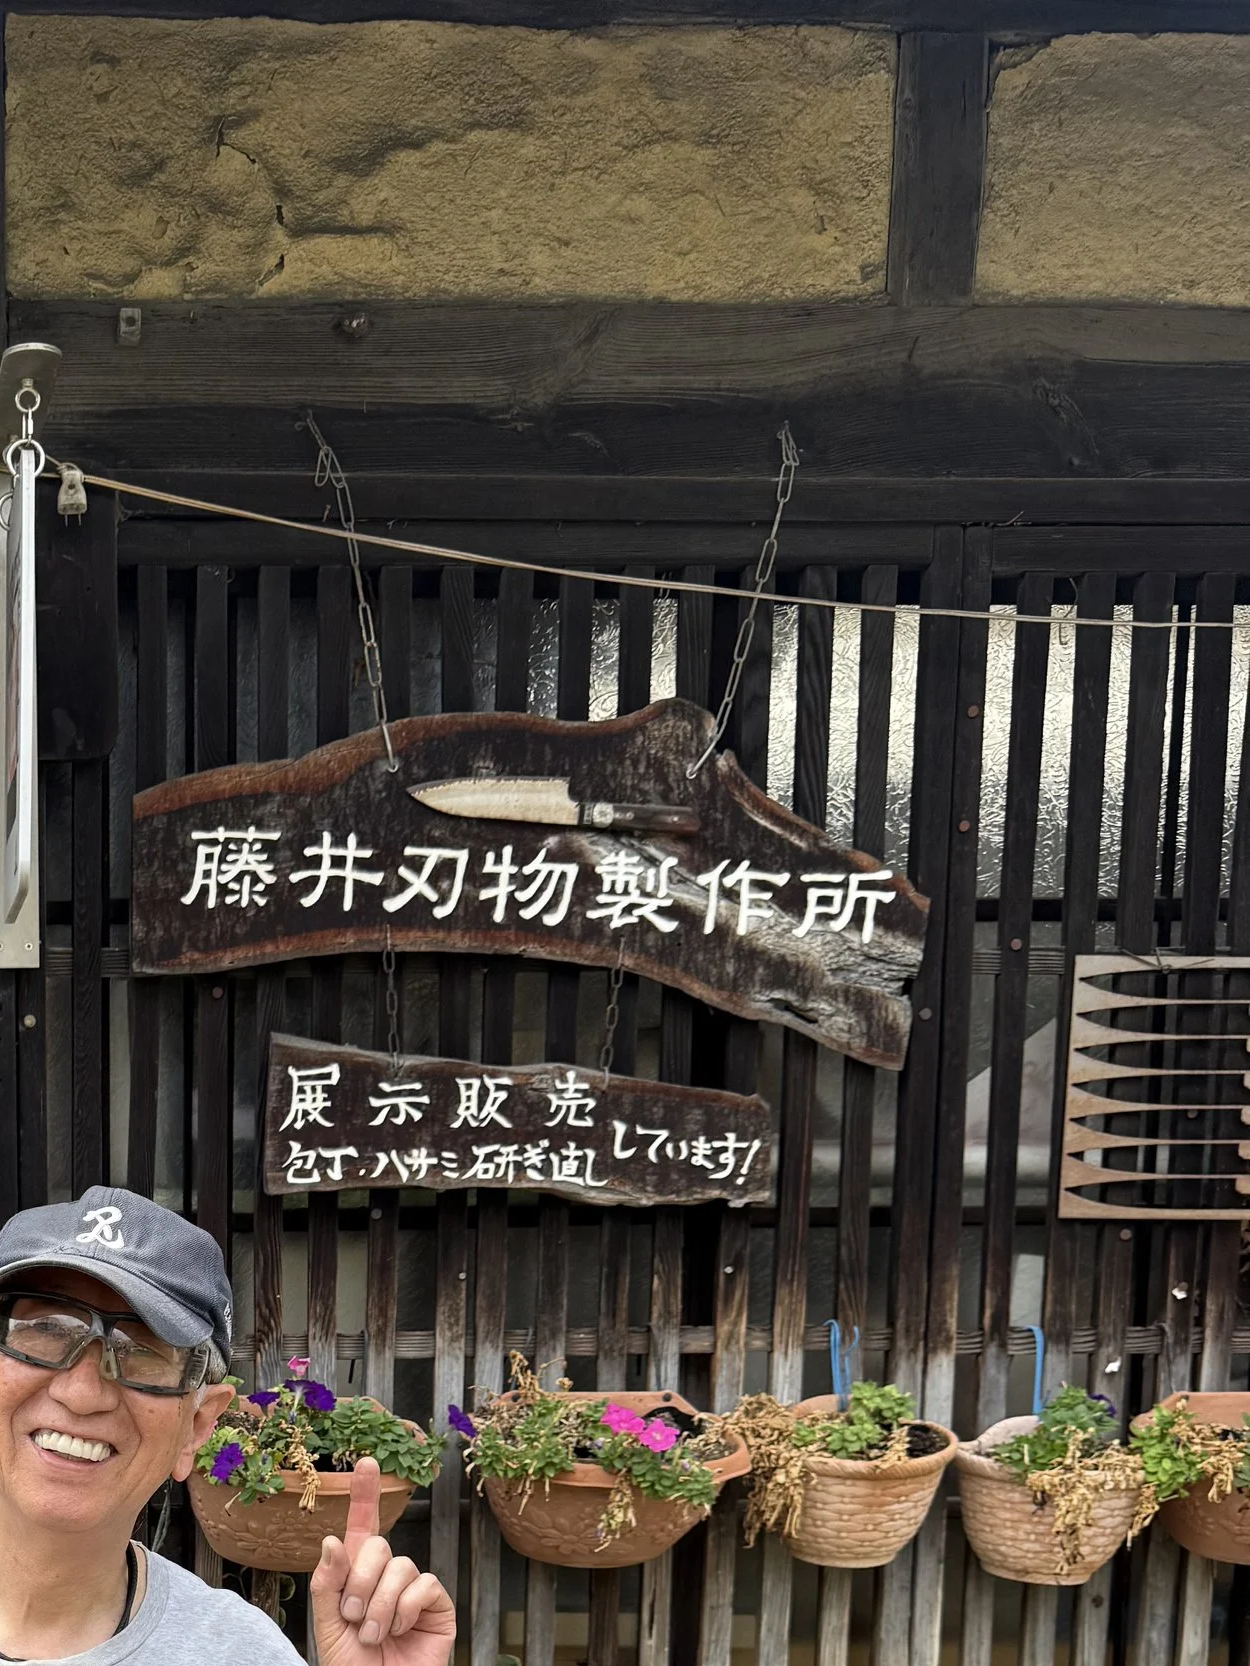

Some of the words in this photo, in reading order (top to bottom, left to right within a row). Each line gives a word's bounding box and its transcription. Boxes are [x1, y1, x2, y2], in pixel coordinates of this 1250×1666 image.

[181, 826, 897, 943] 藤井刃物製作所
[278, 1063, 596, 1132] 展示販売
[612, 1120, 762, 1186] しています!
